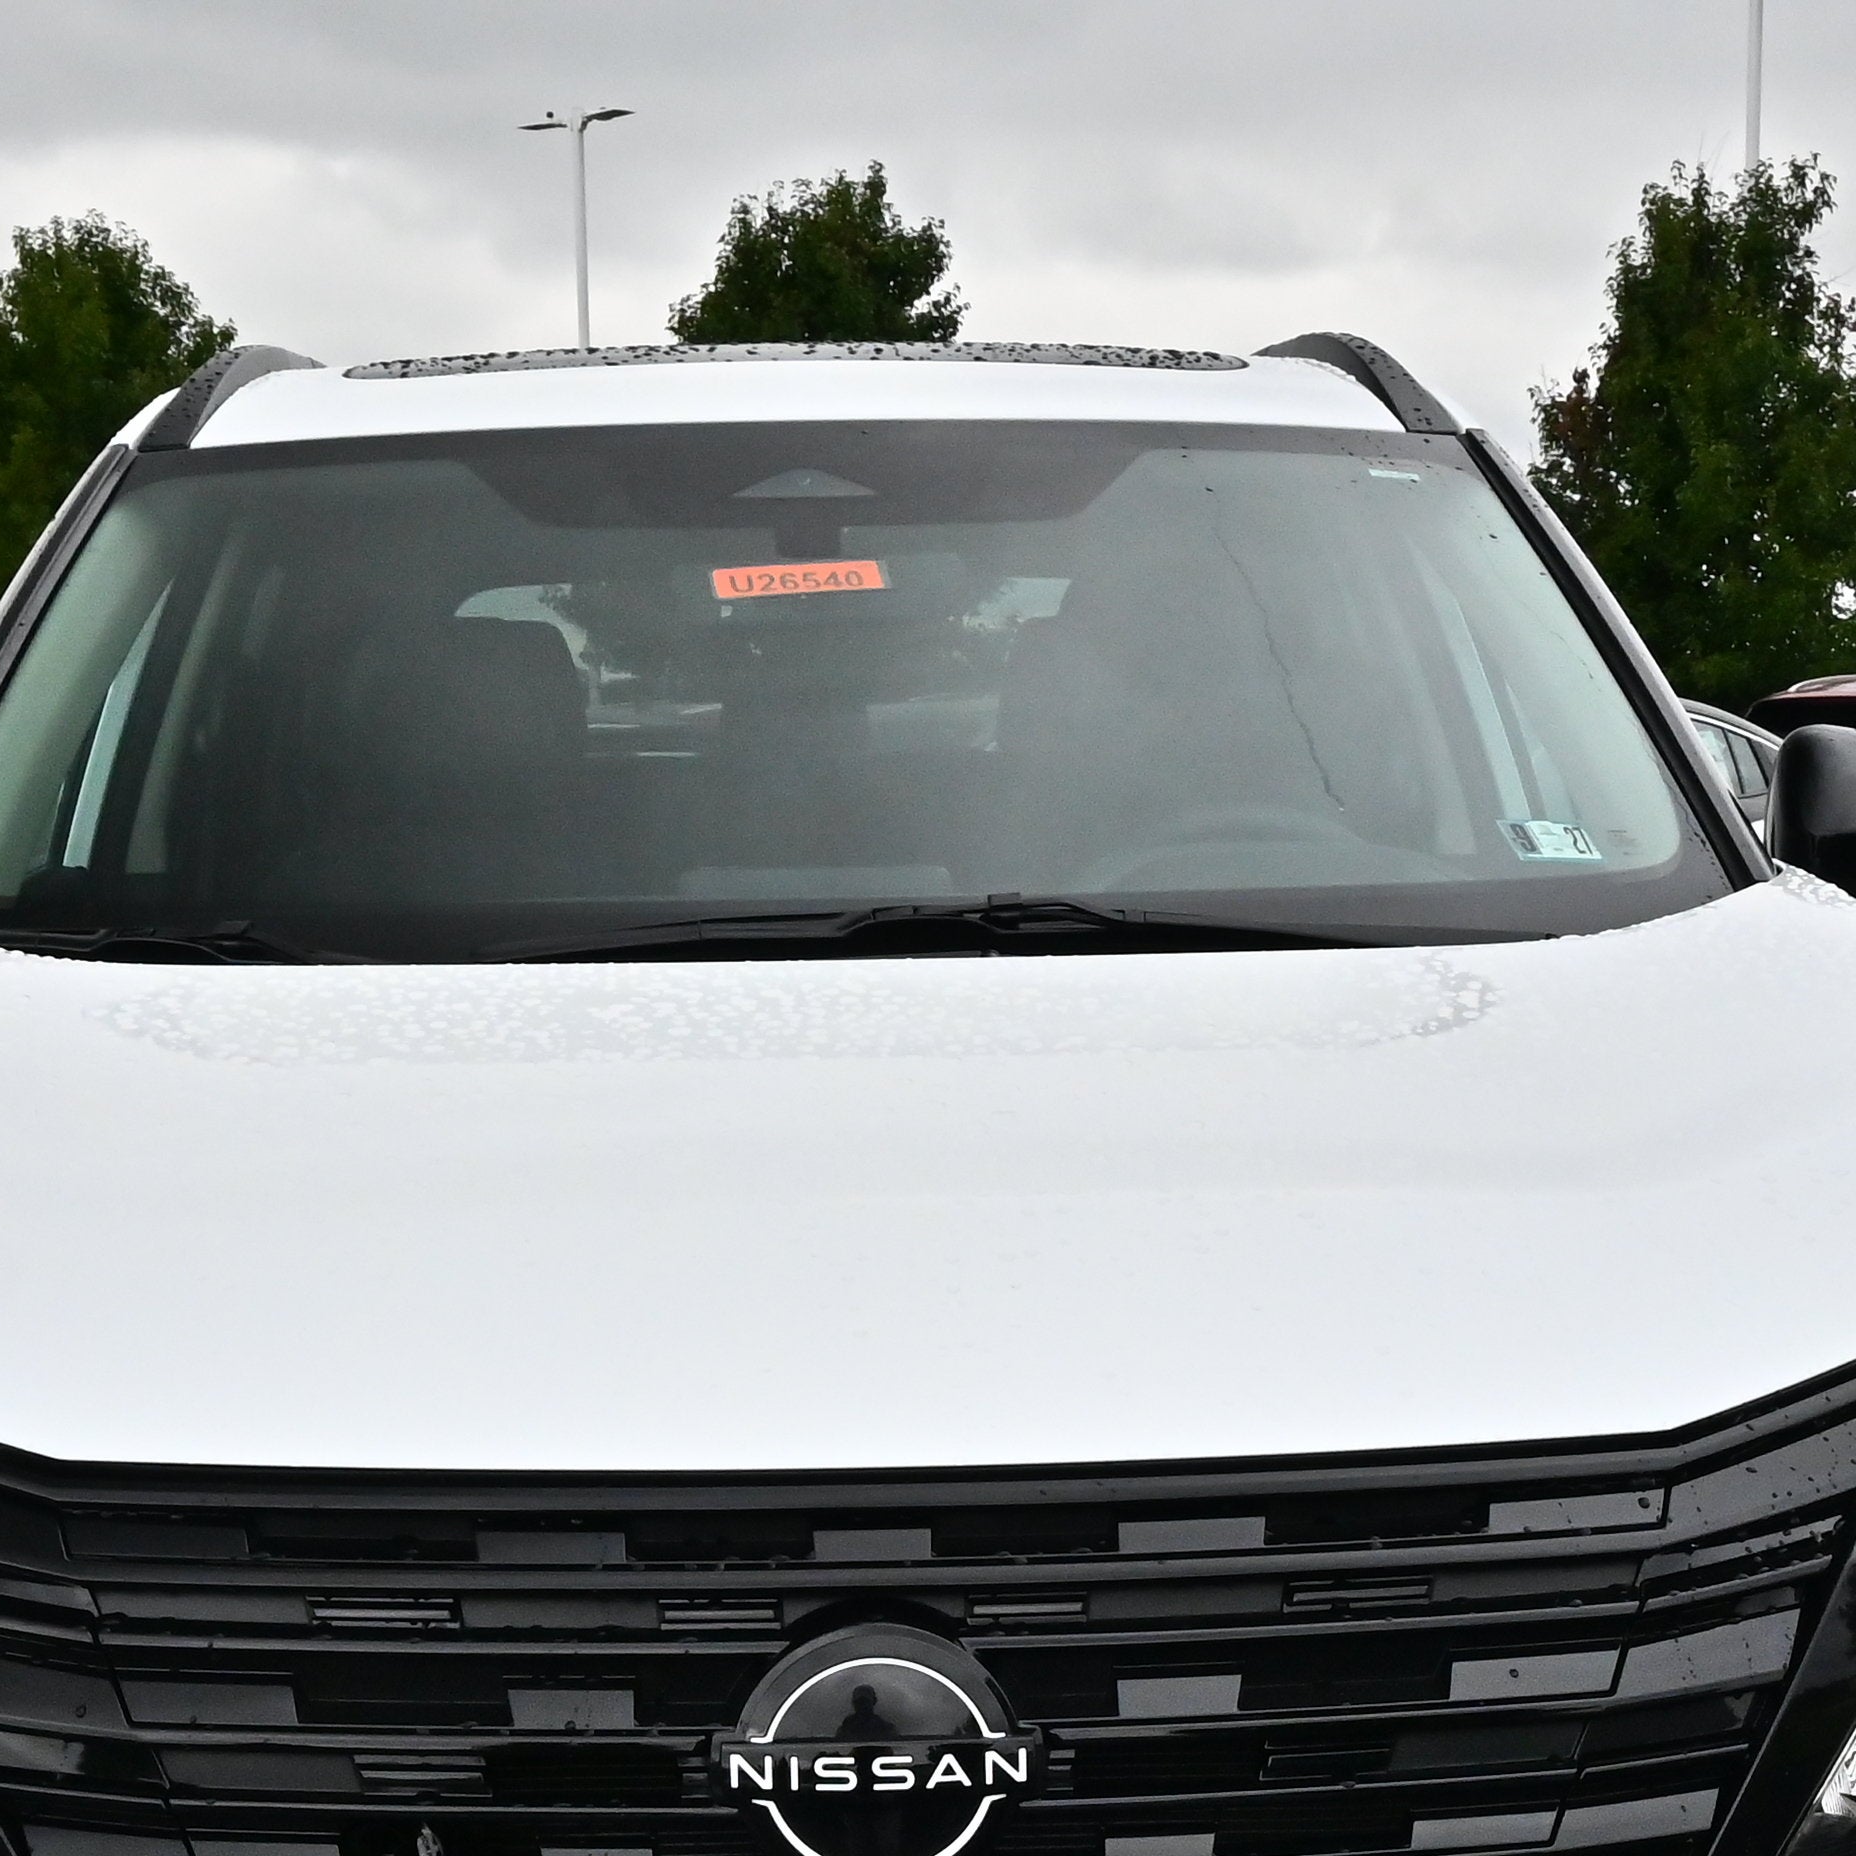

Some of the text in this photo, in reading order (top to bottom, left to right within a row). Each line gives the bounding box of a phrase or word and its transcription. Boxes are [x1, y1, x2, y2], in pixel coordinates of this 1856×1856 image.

[729, 570, 864, 593] U26540
[1563, 826, 1593, 856] 27
[729, 1747, 1028, 1791] NISSAN
